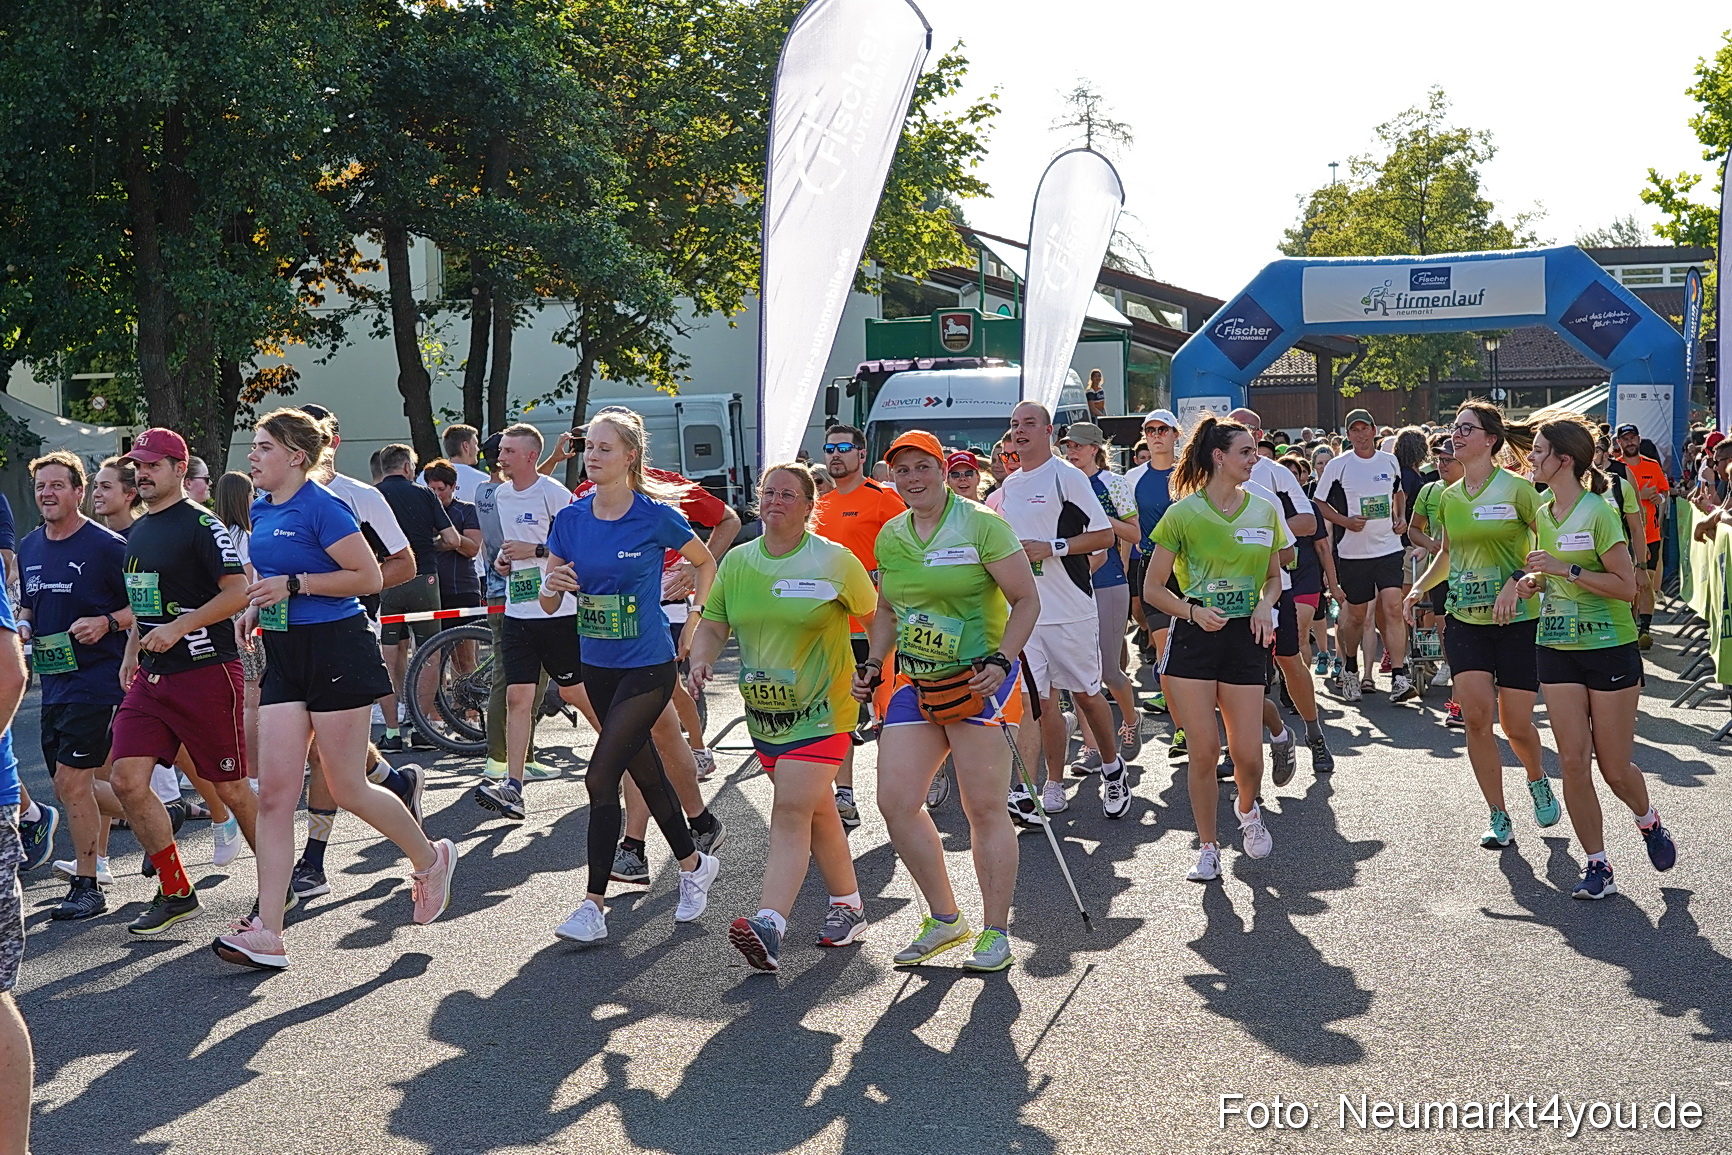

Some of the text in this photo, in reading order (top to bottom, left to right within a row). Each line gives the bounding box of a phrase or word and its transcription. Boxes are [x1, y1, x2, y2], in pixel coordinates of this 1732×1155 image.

[817, 18, 880, 167] Fischer
[1418, 274, 1448, 283] Fischer
[1395, 288, 1486, 310] firmenlauf
[1224, 324, 1272, 336] Fischer
[882, 397, 921, 408] abavent
[1369, 503, 1385, 513] 535
[279, 529, 296, 537] Berger
[625, 551, 641, 559] Berger
[515, 579, 533, 593] 538
[1465, 581, 1488, 595] 921
[131, 588, 149, 602] 851
[1216, 590, 1245, 605] 924
[584, 609, 606, 624] 446
[1545, 615, 1565, 631] 922
[913, 627, 943, 649] 214
[64, 647, 74, 666] 2022
[948, 638, 956, 660] 2022
[751, 684, 787, 700] 1511
[788, 688, 798, 707] 2022
